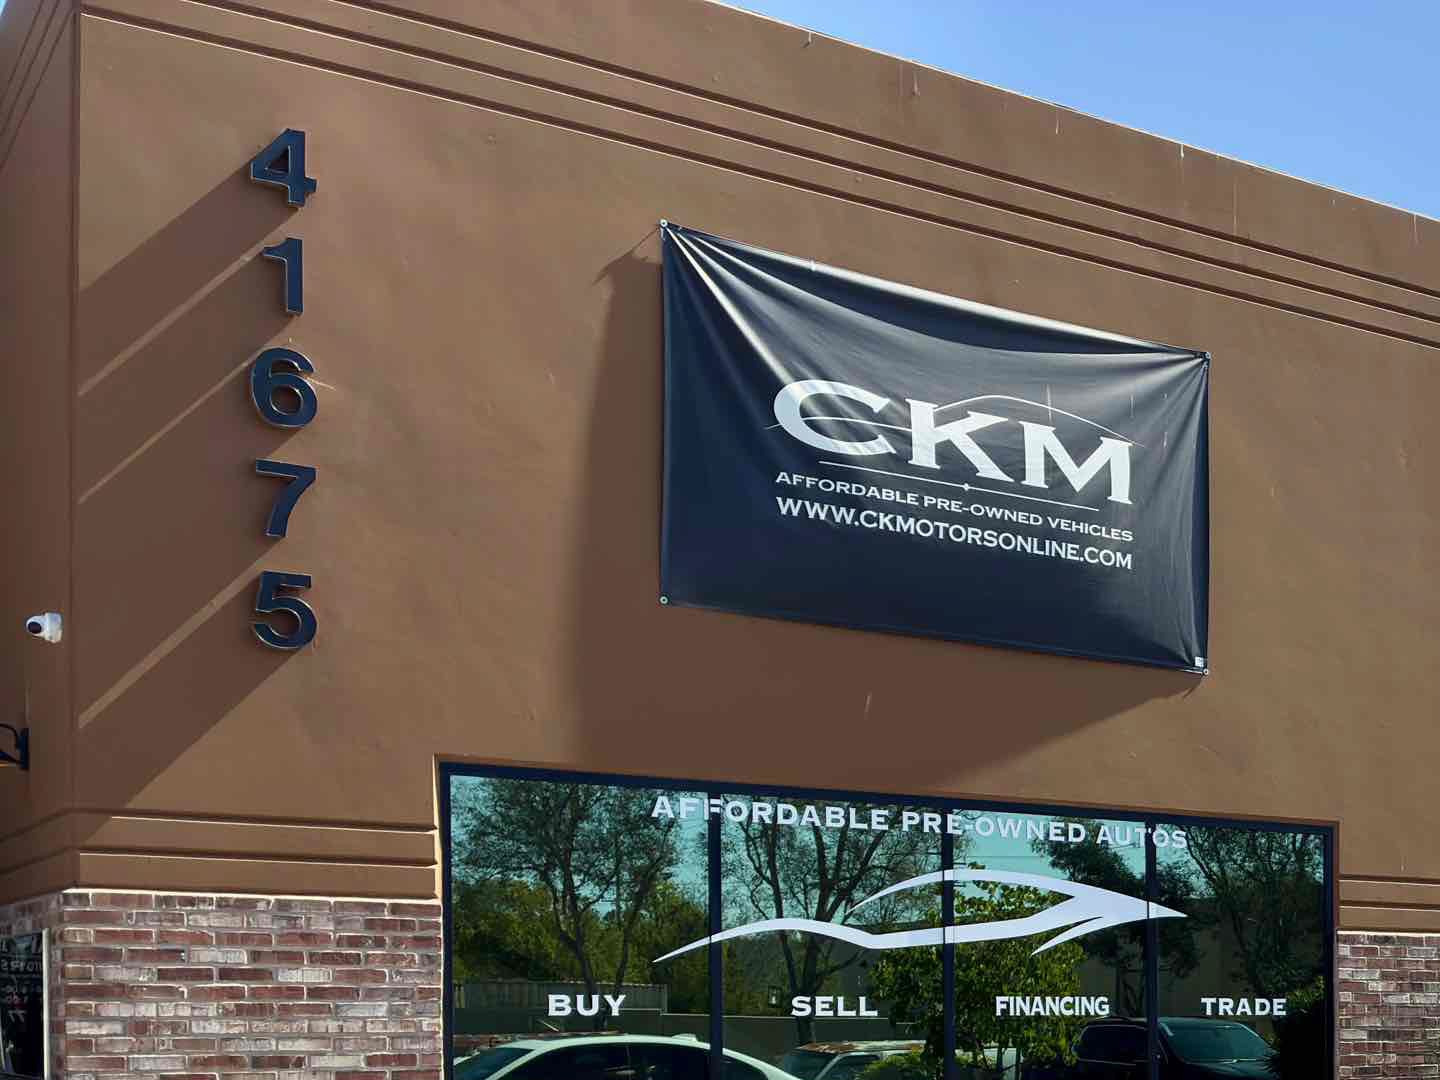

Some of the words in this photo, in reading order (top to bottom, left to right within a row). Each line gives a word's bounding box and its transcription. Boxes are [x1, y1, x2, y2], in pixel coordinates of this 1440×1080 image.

[249, 127, 318, 650] 41675
[774, 379, 1133, 505] CKM
[775, 471, 919, 507] AFFORDABLE
[923, 495, 1043, 526] PRE-OWNED
[1046, 516, 1134, 542] VEHICLES
[775, 496, 1133, 570] WWW.CKMOTORSONLINE.COM
[651, 795, 889, 831] AFFORDABLE
[901, 810, 1087, 843] PRE-OWNED
[1095, 825, 1188, 849] AUTOS
[547, 994, 627, 1017] BUY
[790, 995, 879, 1017] SELL
[995, 996, 1110, 1017] FINANCING
[1200, 997, 1287, 1016] TRADE
